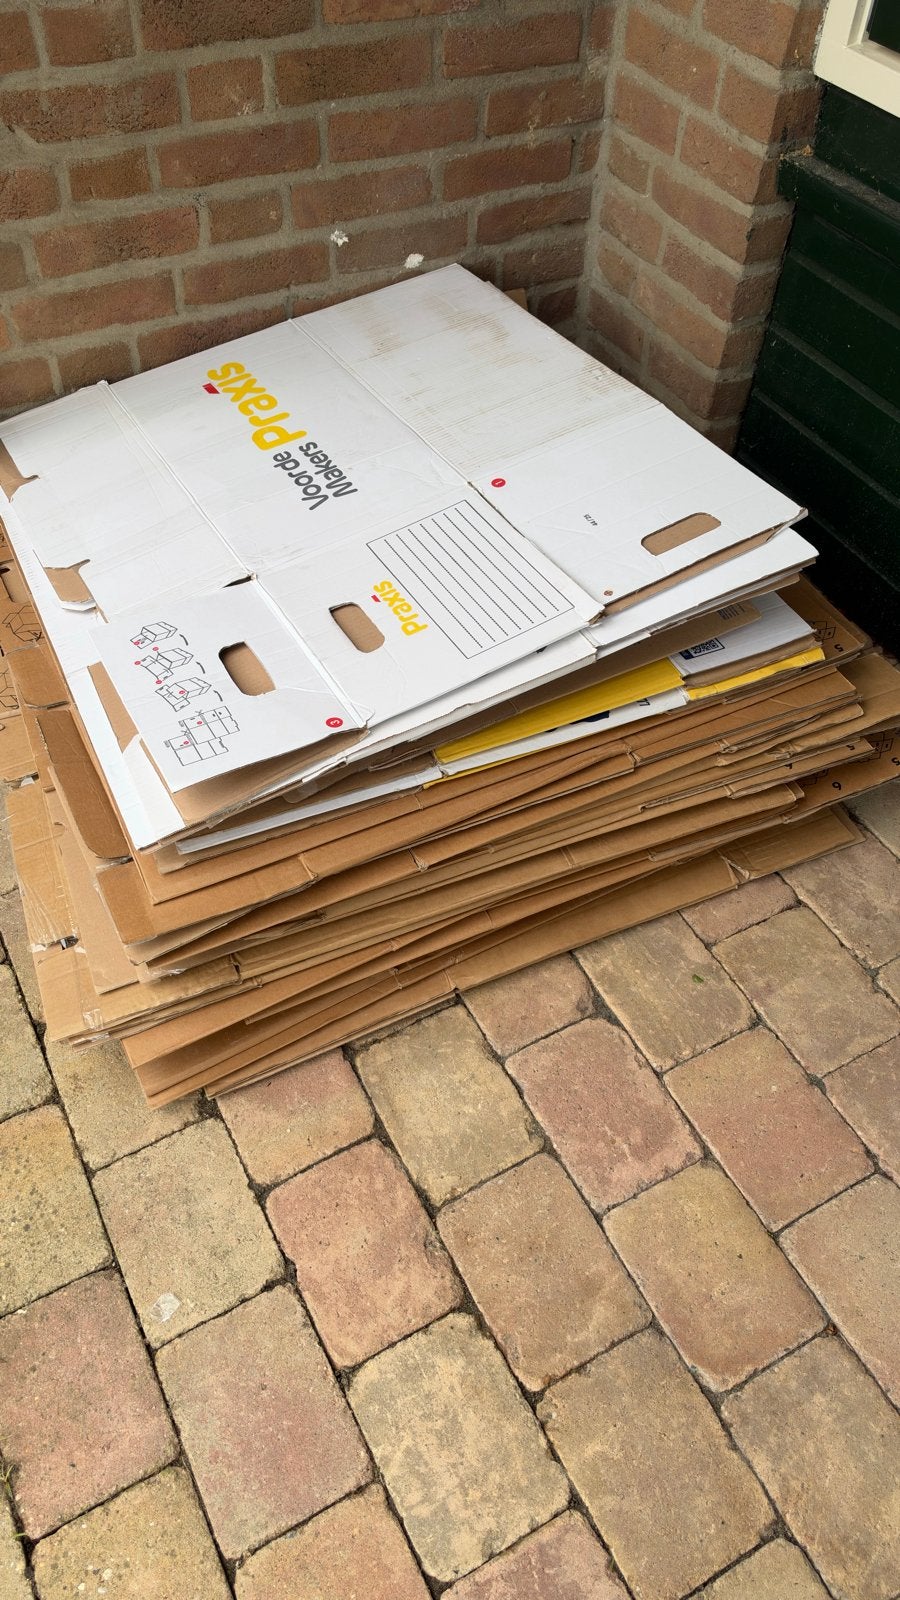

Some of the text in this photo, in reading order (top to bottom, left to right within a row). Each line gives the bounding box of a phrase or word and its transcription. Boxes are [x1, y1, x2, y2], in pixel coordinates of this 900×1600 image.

[207, 362, 307, 450] Praxis
[299, 442, 358, 498] Makers
[373, 580, 428, 636] Praxis
